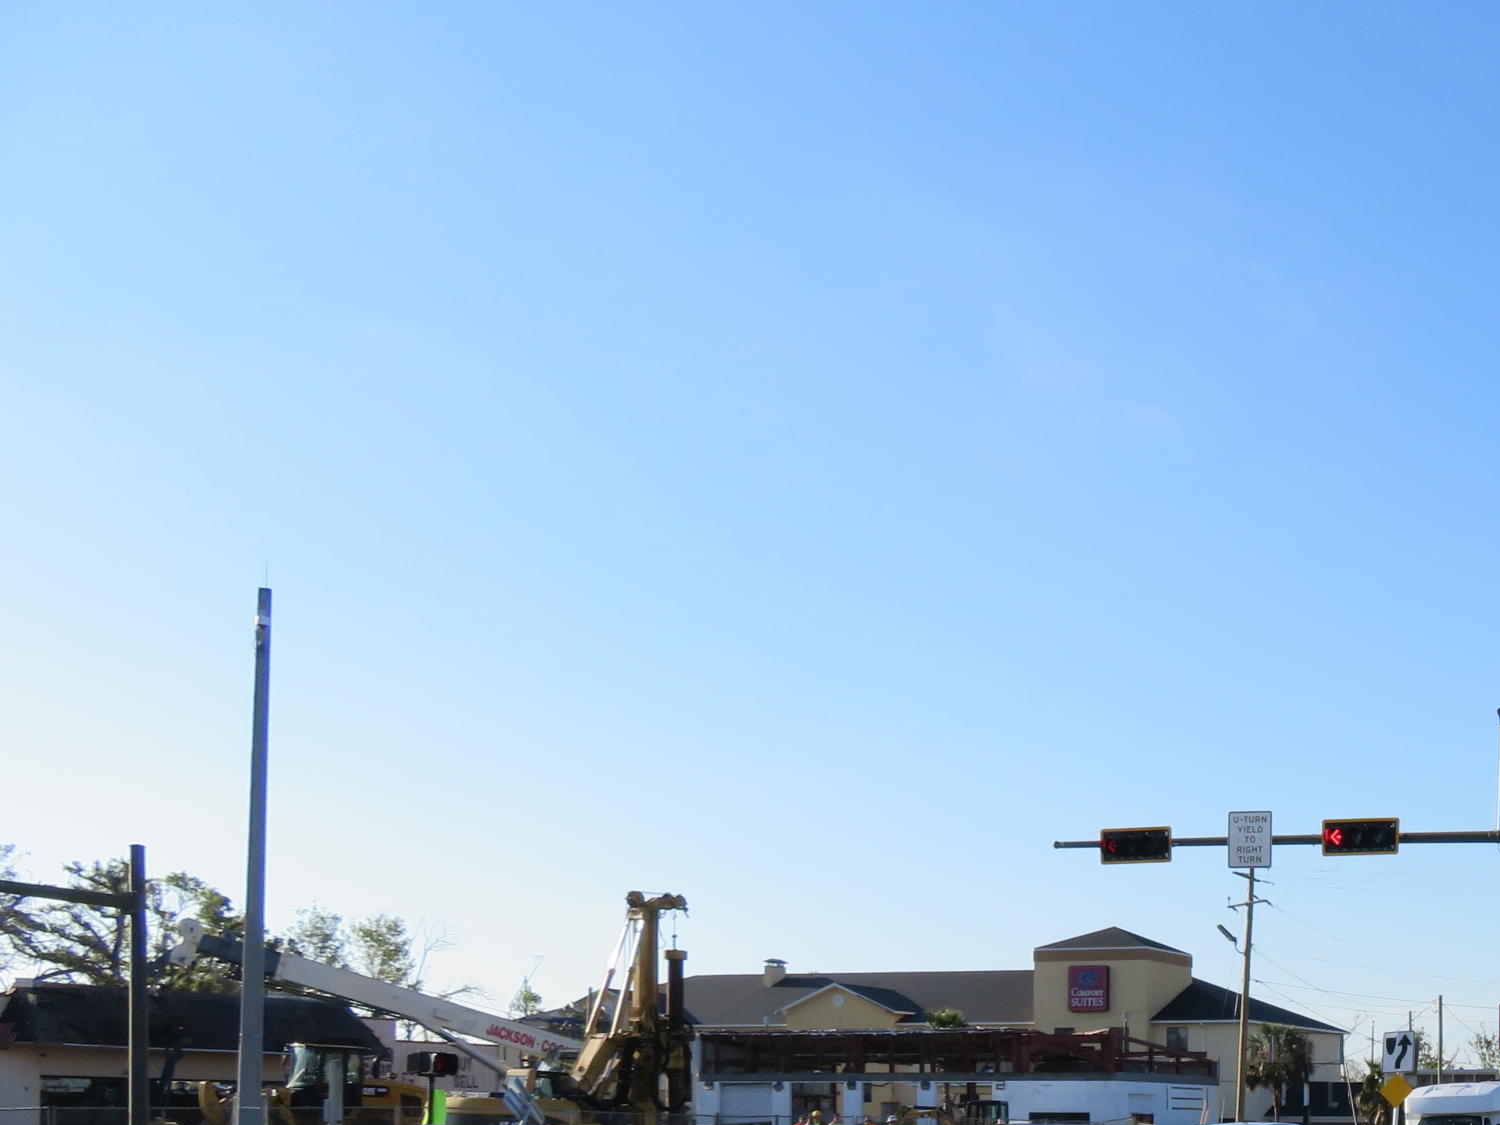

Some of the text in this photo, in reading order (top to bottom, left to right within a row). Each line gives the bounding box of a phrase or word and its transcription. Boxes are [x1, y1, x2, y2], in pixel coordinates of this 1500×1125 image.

[1237, 826, 1264, 834] YIELD
[1236, 846, 1263, 854] RIGHT
[1071, 997, 1104, 1007] SUITES
[486, 1024, 536, 1048] JACKSON
[454, 1074, 479, 1089] SELL
